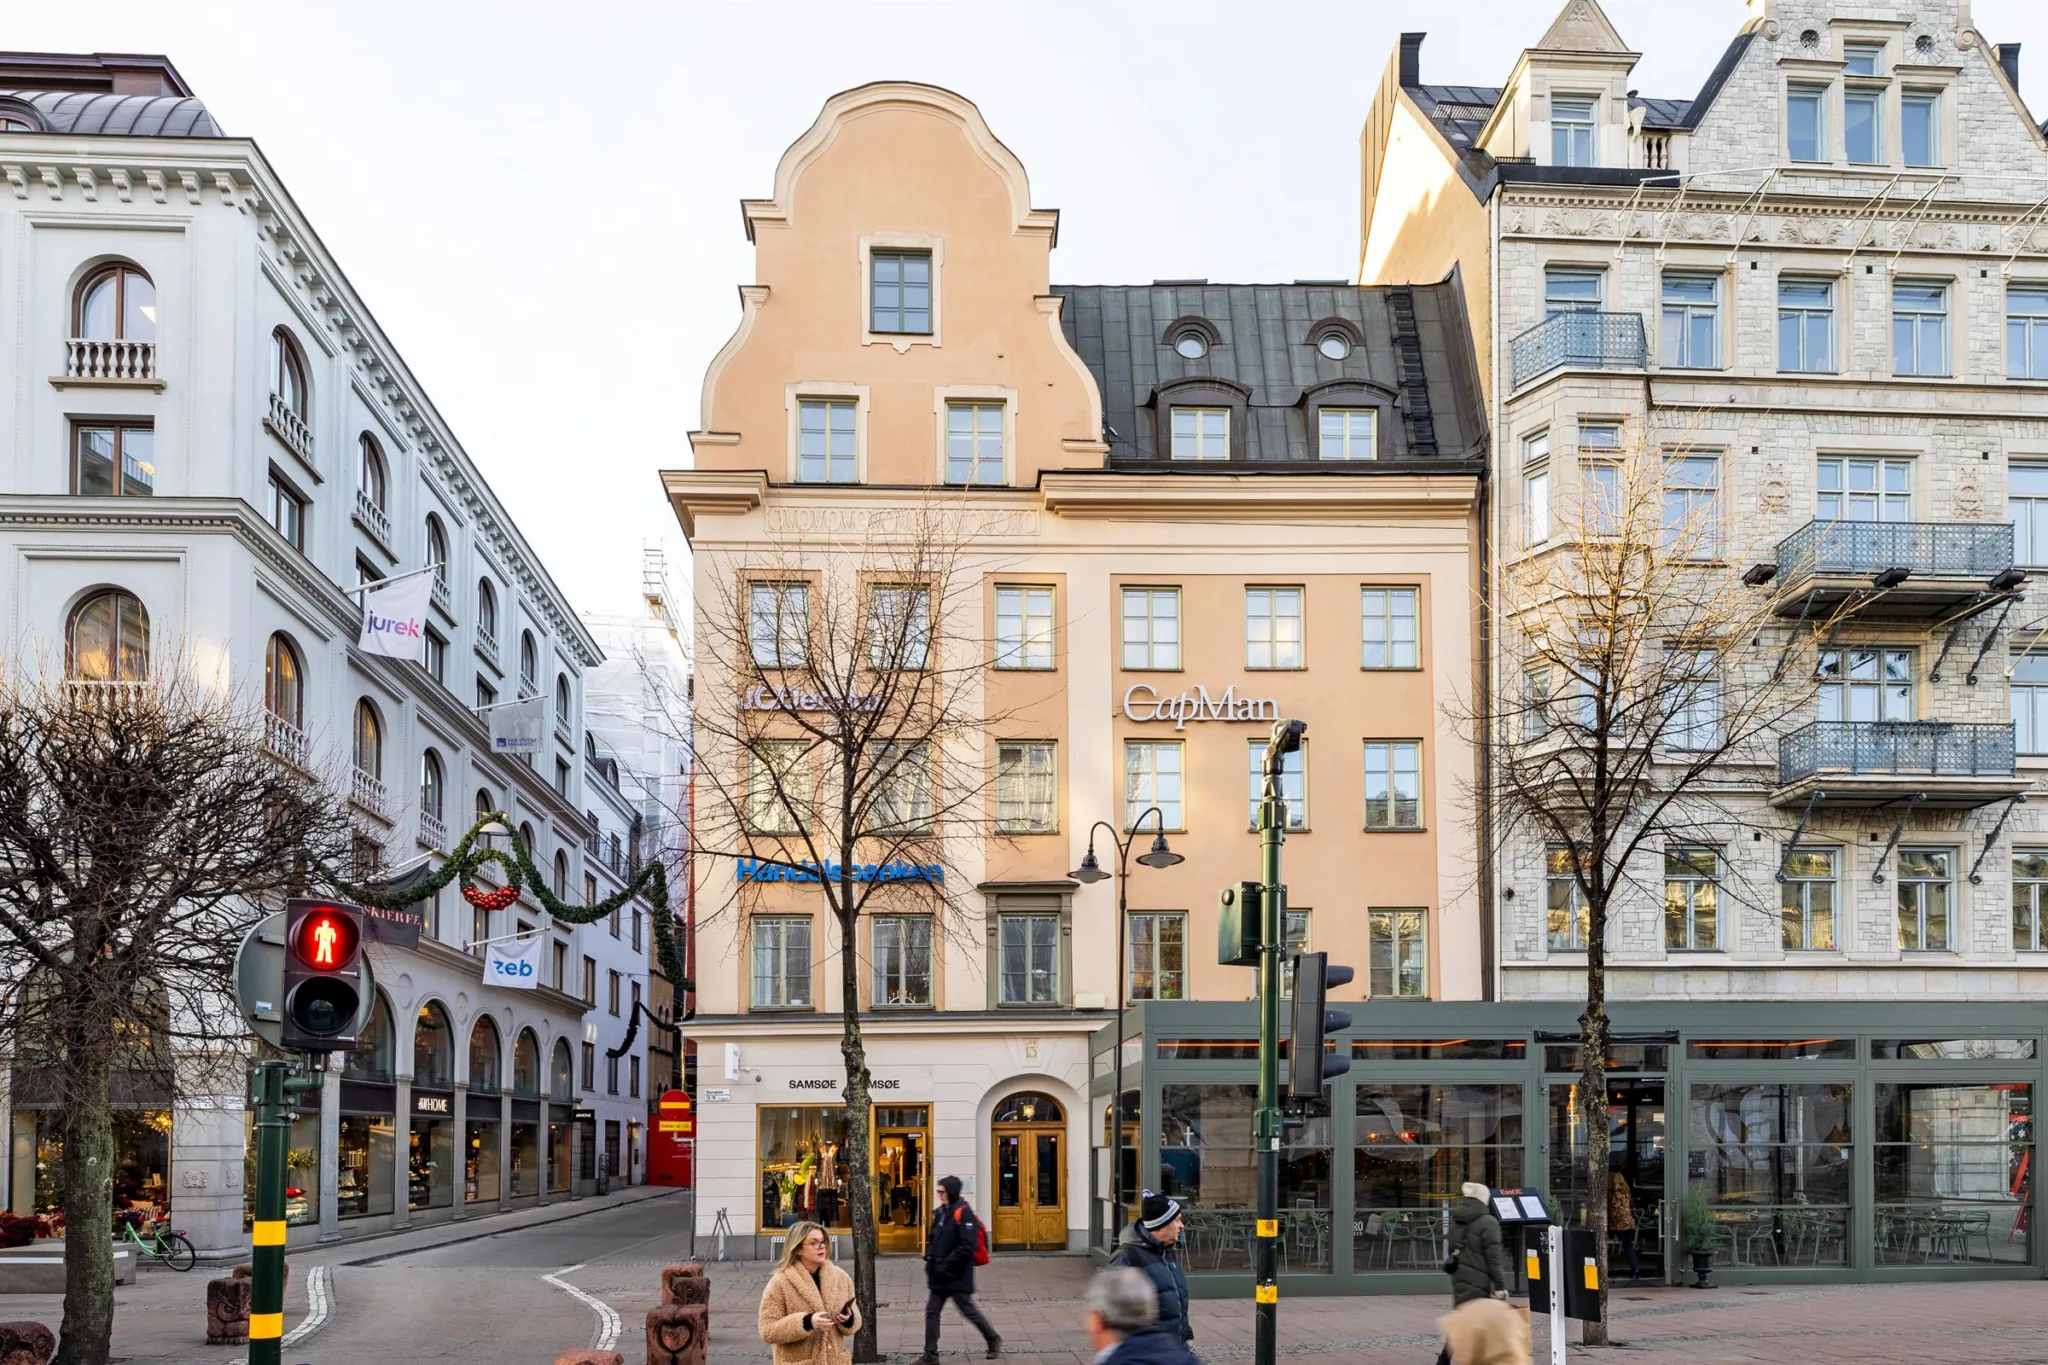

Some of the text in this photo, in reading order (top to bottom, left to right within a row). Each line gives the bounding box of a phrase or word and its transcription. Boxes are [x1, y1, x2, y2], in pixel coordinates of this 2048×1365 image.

[367, 610, 420, 638] jurek
[1123, 684, 1280, 730] CapMan
[492, 959, 533, 977] zeb
[1024, 1045, 1038, 1059] 13
[788, 1079, 900, 1089] SAMSØE MSØE
